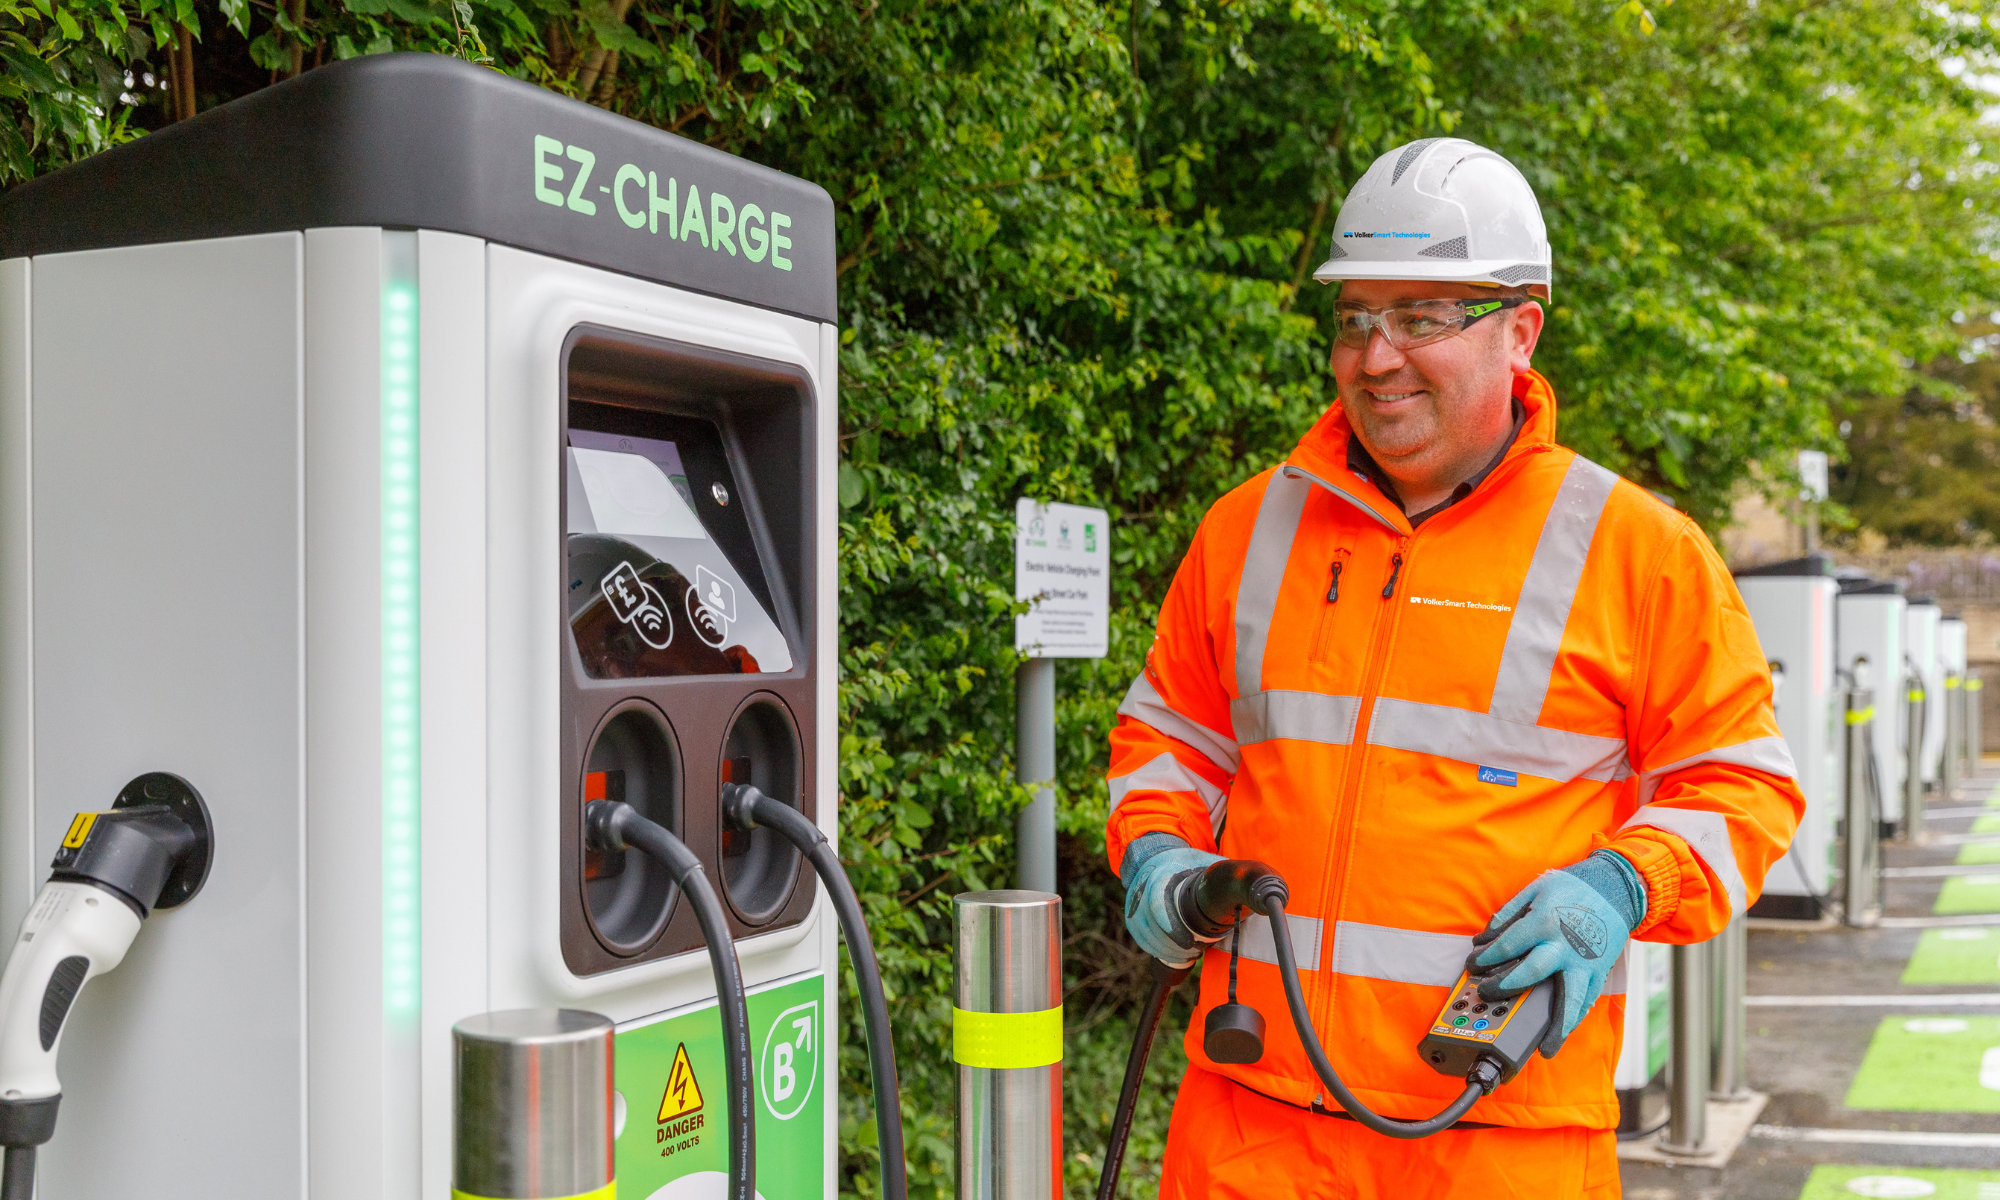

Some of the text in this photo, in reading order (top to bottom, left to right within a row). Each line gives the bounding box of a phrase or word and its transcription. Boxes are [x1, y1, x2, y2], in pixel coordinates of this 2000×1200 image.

[534, 134, 793, 271] EZ-CHARGE
[1391, 231, 1431, 239] Technologies
[1422, 597, 1512, 612] VolkerSmart Technologies
[732, 961, 742, 997] ELECTRON
[656, 1113, 704, 1144] DANGER
[661, 1135, 700, 1158] 400 VOLTS
